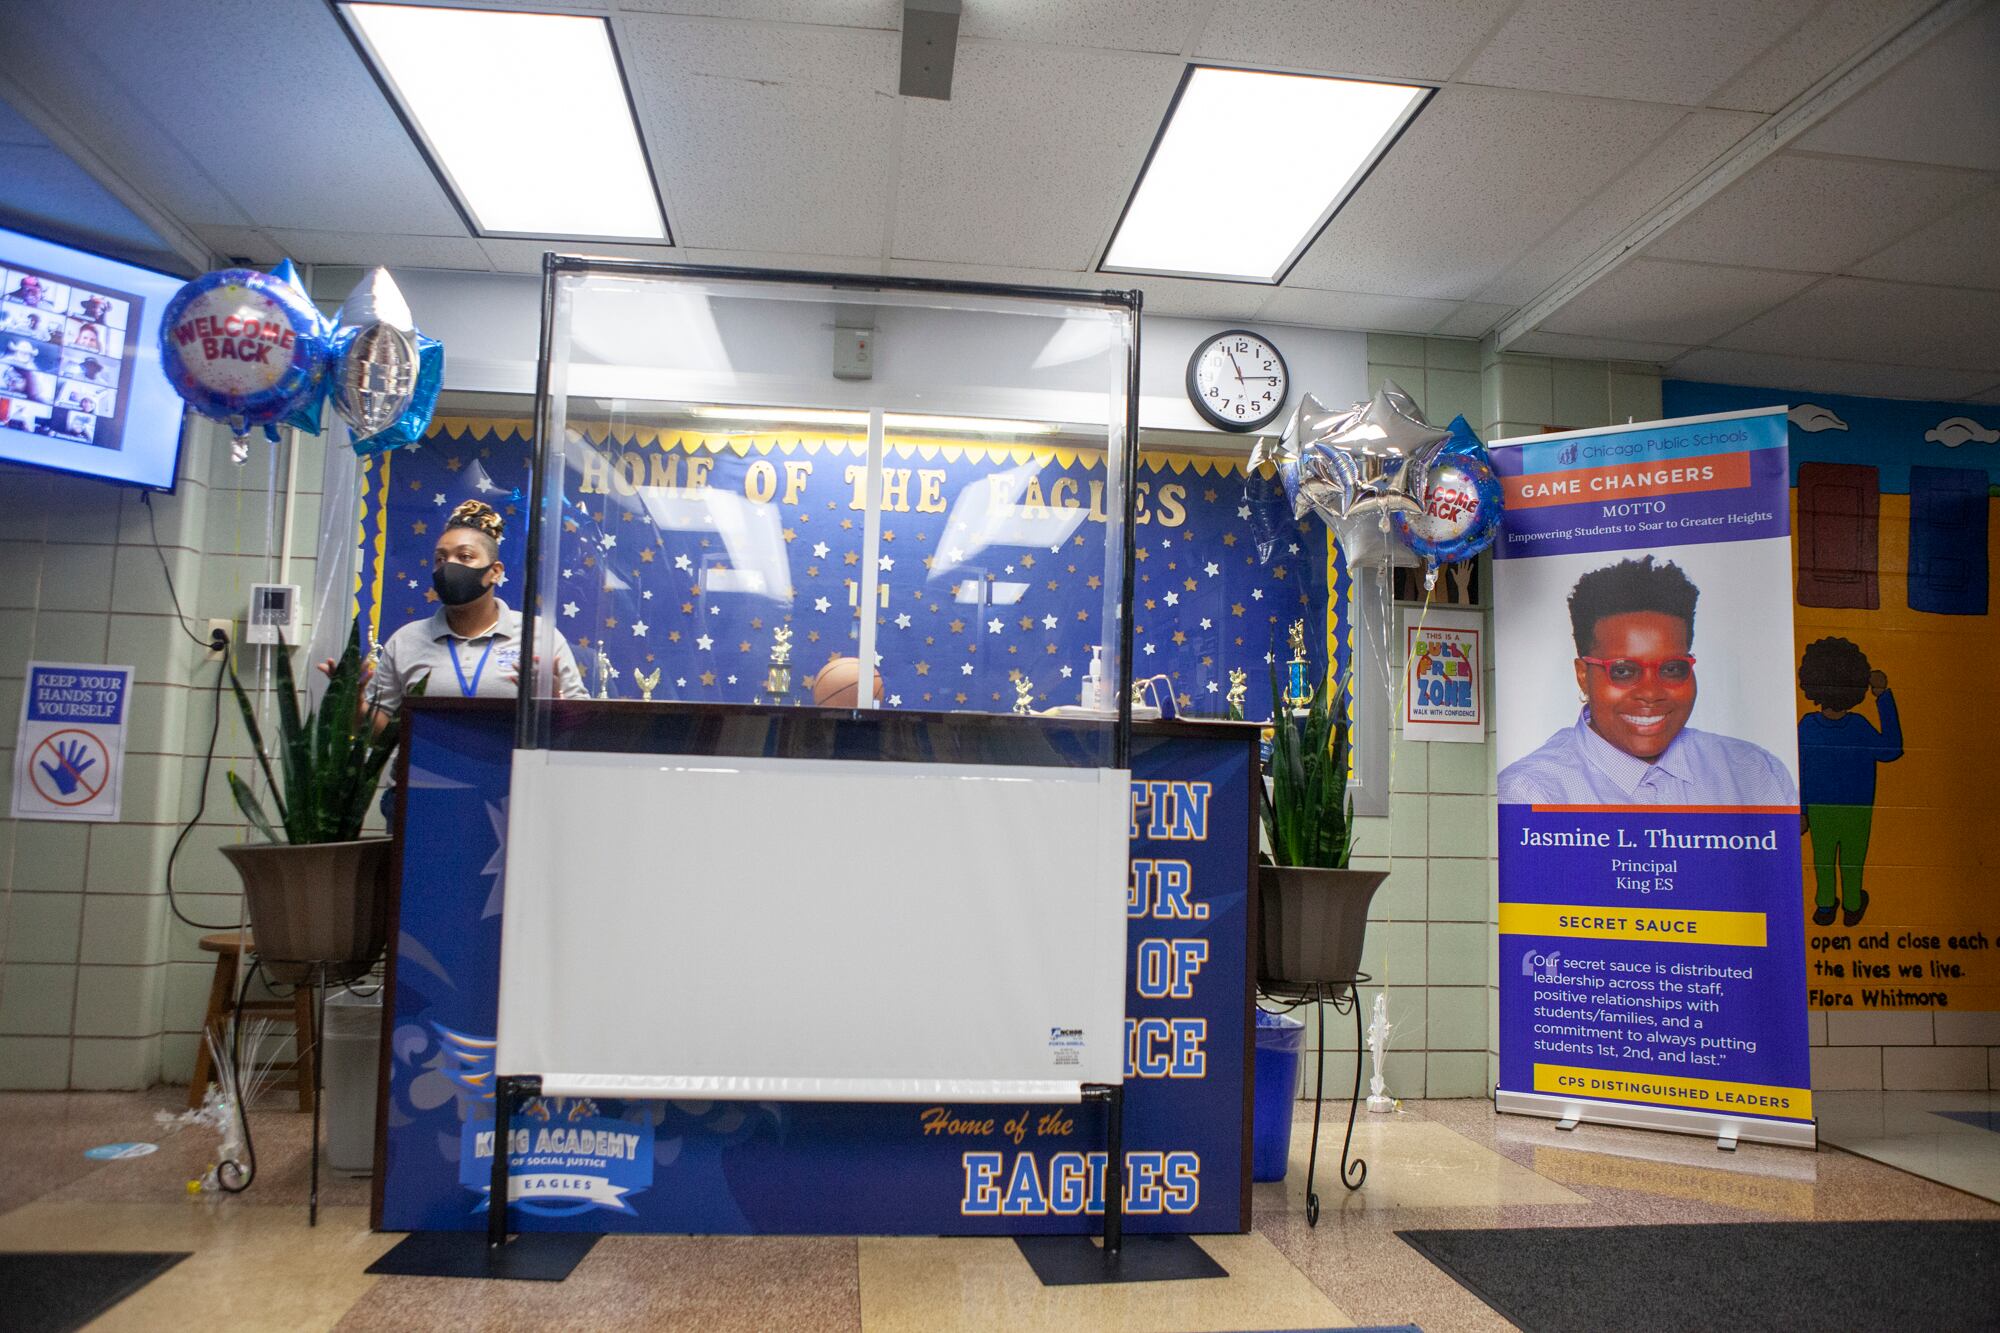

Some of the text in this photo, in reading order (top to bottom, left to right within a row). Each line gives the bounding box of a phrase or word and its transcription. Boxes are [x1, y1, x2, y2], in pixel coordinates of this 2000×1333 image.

[173, 314, 296, 350] WELCOME
[203, 339, 273, 365] BACK
[1236, 342, 1248, 353] 12
[1256, 349, 1259, 358] 1
[1263, 361, 1271, 371] 2
[1268, 376, 1277, 386] 3
[1210, 387, 1219, 397] 8
[1262, 391, 1271, 400] 4
[1222, 399, 1229, 408] 7
[1236, 404, 1245, 414] 6
[1251, 401, 1260, 411] 5
[1582, 430, 1748, 459] Chicago Public Schools
[579, 451, 714, 500] HOME
[744, 460, 814, 505] OF
[845, 465, 947, 513] THE
[1521, 466, 1714, 498] GAME CHANGERS
[1423, 484, 1480, 513] LCOME
[1424, 501, 1462, 523] ACK
[1602, 501, 1666, 517] MOTTO
[1508, 529, 1573, 543] Empowering
[1574, 525, 1621, 536] Students
[1638, 521, 1664, 531] Soar
[1666, 520, 1678, 528] to
[1680, 516, 1724, 527] Greater
[1727, 512, 1772, 524] Heights
[1426, 632, 1442, 640] THIS
[1416, 641, 1472, 658] BULLY
[1420, 655, 1470, 677] FREE
[37, 674, 122, 690] KEEP YOUR
[38, 688, 117, 704] HANDS TO
[1418, 679, 1472, 708] ZONE
[38, 702, 116, 717] YOURSELF
[1520, 827, 1778, 850] Jasmine L. Thurmond
[1611, 859, 1677, 875] Principal
[1127, 859, 1210, 920] JR.
[1616, 877, 1673, 894] King ES
[1559, 916, 1697, 934] SECRET SAUCE
[1811, 935, 1851, 953] open
[1858, 932, 1889, 949] and
[1897, 932, 1941, 950] close
[1948, 932, 1989, 950] each
[1137, 939, 1208, 998] OF
[1563, 959, 1605, 971] secret
[1609, 962, 1651, 973] sauce
[1655, 962, 1666, 974] is
[1670, 963, 1753, 979] distributed
[1814, 960, 1966, 978] the lives we live.
[1534, 972, 1724, 997] leadership across the staff,
[1534, 990, 1719, 1012] positive relationships with
[1809, 989, 1948, 1007] Flora Whitmore
[1534, 1006, 1703, 1029] students/families, and a
[1534, 1024, 1757, 1053] commitment to always putting
[1534, 1039, 1594, 1054] students
[1623, 1046, 1654, 1061] 2nd,
[1658, 1051, 1686, 1063] and
[1558, 1076, 1790, 1109] CPS DISTINGUISHED LEADERS
[920, 1107, 1074, 1145] Home of the
[534, 1128, 640, 1161] ACADEMY
[511, 1157, 606, 1168] OF SOCIAL JUSTICE
[525, 1178, 592, 1190] EAGLES
